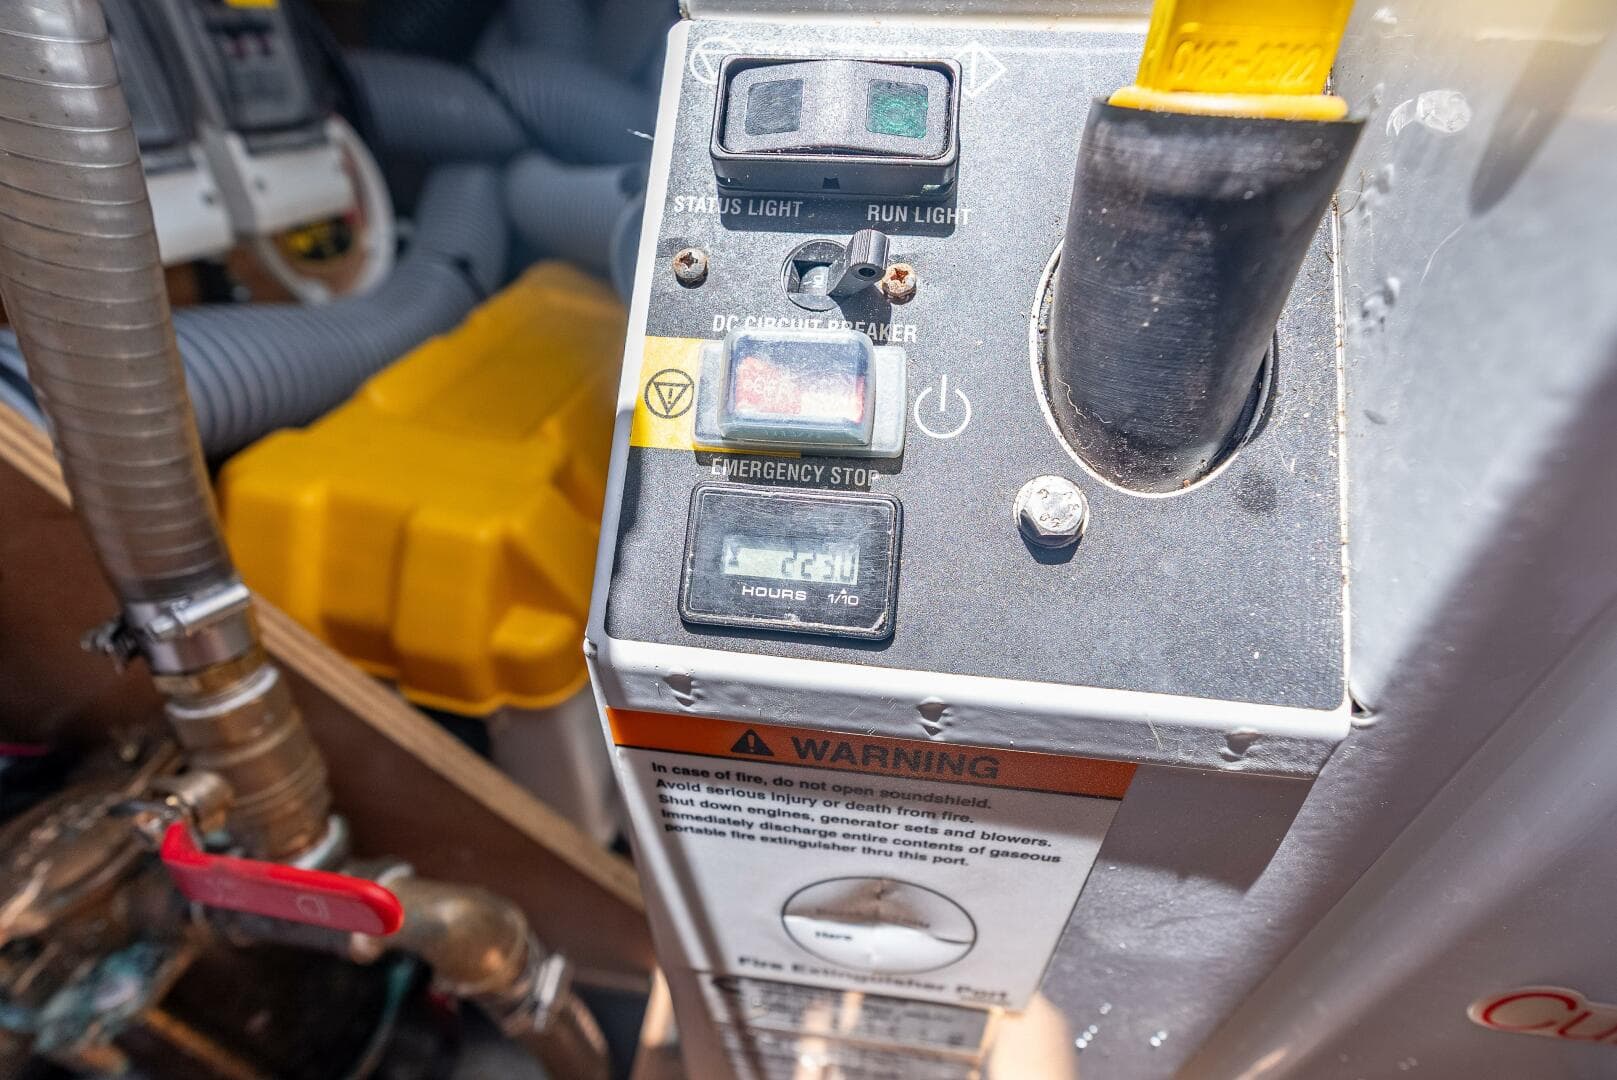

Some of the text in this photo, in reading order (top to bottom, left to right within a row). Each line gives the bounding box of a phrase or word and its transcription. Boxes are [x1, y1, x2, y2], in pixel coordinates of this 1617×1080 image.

[673, 194, 803, 218] STATUS LIGHT
[866, 204, 972, 225] RUN LIGHT
[712, 314, 738, 333] DC
[743, 315, 823, 330] CIRCUIT
[710, 457, 880, 487] EMERGENCY STOP
[741, 585, 859, 606] HOURS 1/10
[791, 735, 1000, 780] WARNING
[652, 761, 992, 810] In case of fire, do not open soundshield.
[656, 778, 975, 824] Avoid serious injury or death from fire.
[658, 793, 1052, 848] Shut down engines, generator sets and blowers.
[661, 809, 1061, 864] Immediately discharge entire contents of gaseous
[665, 823, 969, 868] portable fire extinguisher thru this port.
[738, 957, 784, 973] Fire
